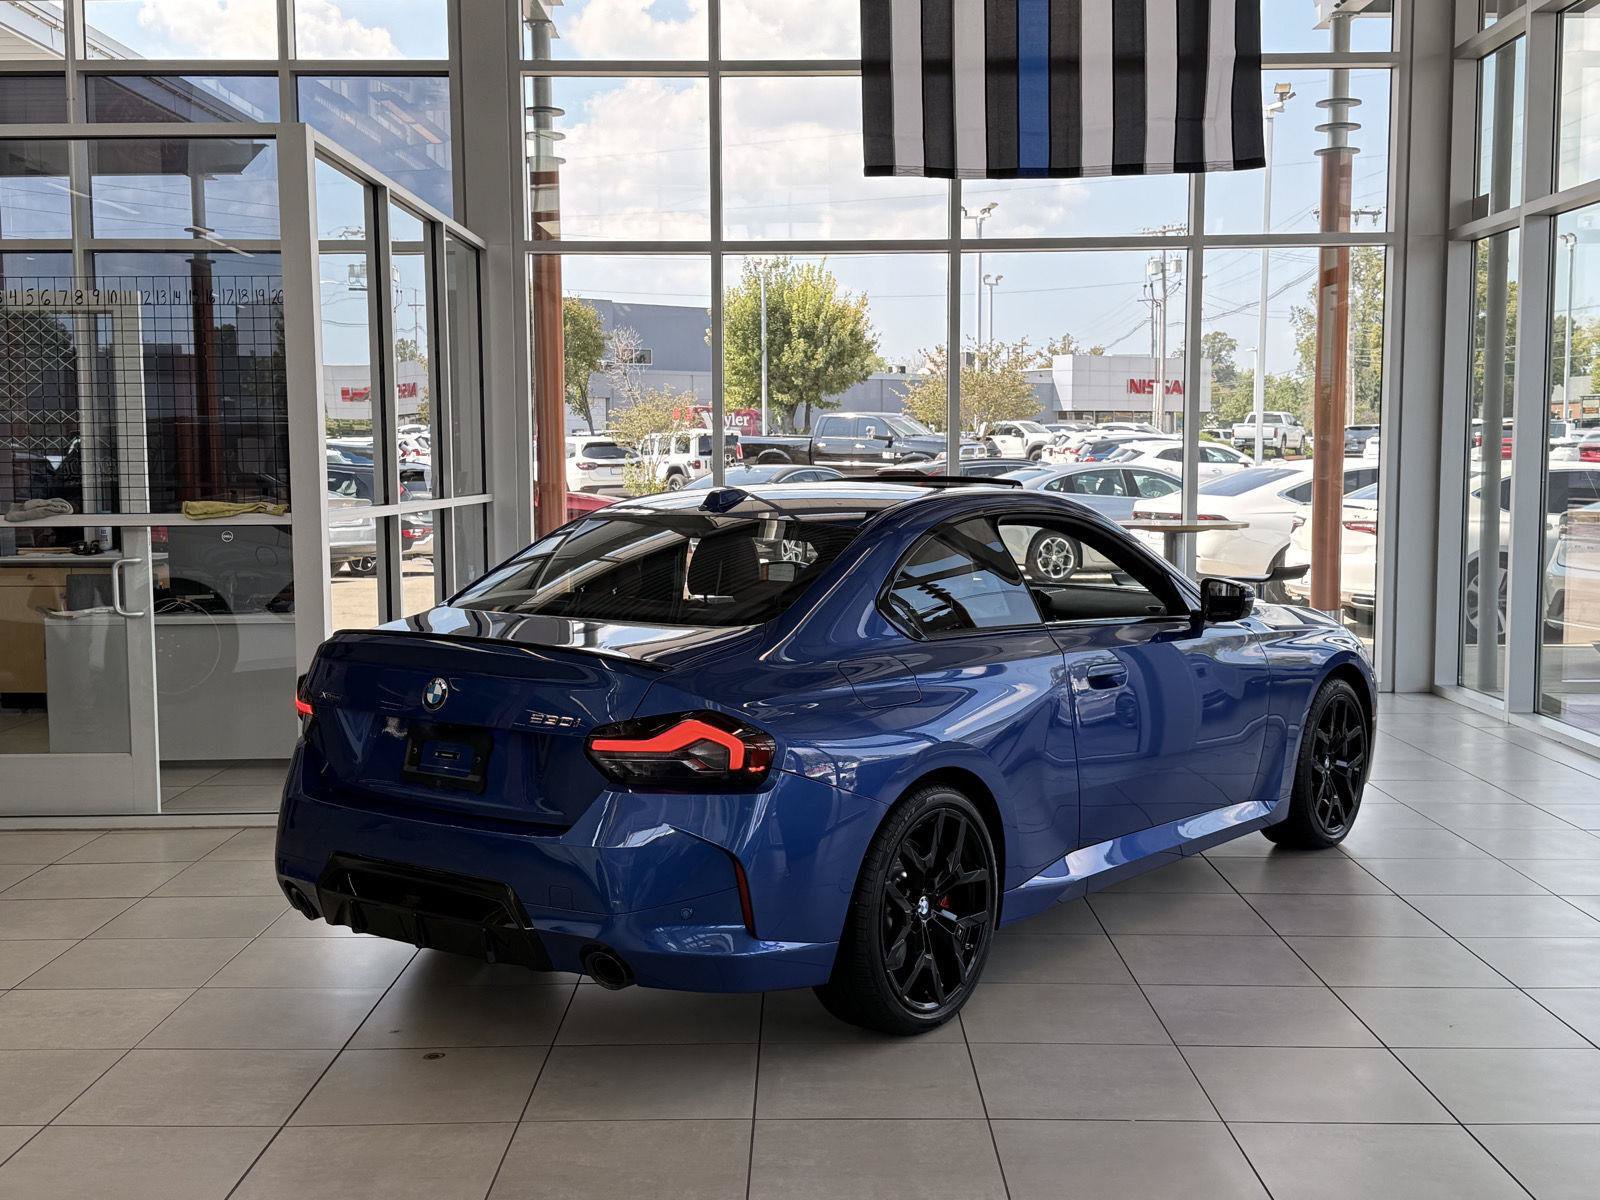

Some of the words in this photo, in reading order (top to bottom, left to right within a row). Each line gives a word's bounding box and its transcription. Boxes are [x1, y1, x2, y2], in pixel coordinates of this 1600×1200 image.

[9, 288, 17, 306] 4
[26, 287, 35, 306] 5
[40, 288, 51, 306] 6
[58, 289, 68, 306] 7
[74, 289, 84, 306] 8
[92, 288, 100, 306] 9
[107, 289, 118, 304] 10
[140, 290, 152, 305] 12
[156, 289, 167, 305] 13
[173, 289, 181, 305] 14
[222, 288, 234, 304] 17
[238, 288, 249, 304] 18
[255, 288, 265, 305] 19
[1126, 378, 1184, 394] NISSA
